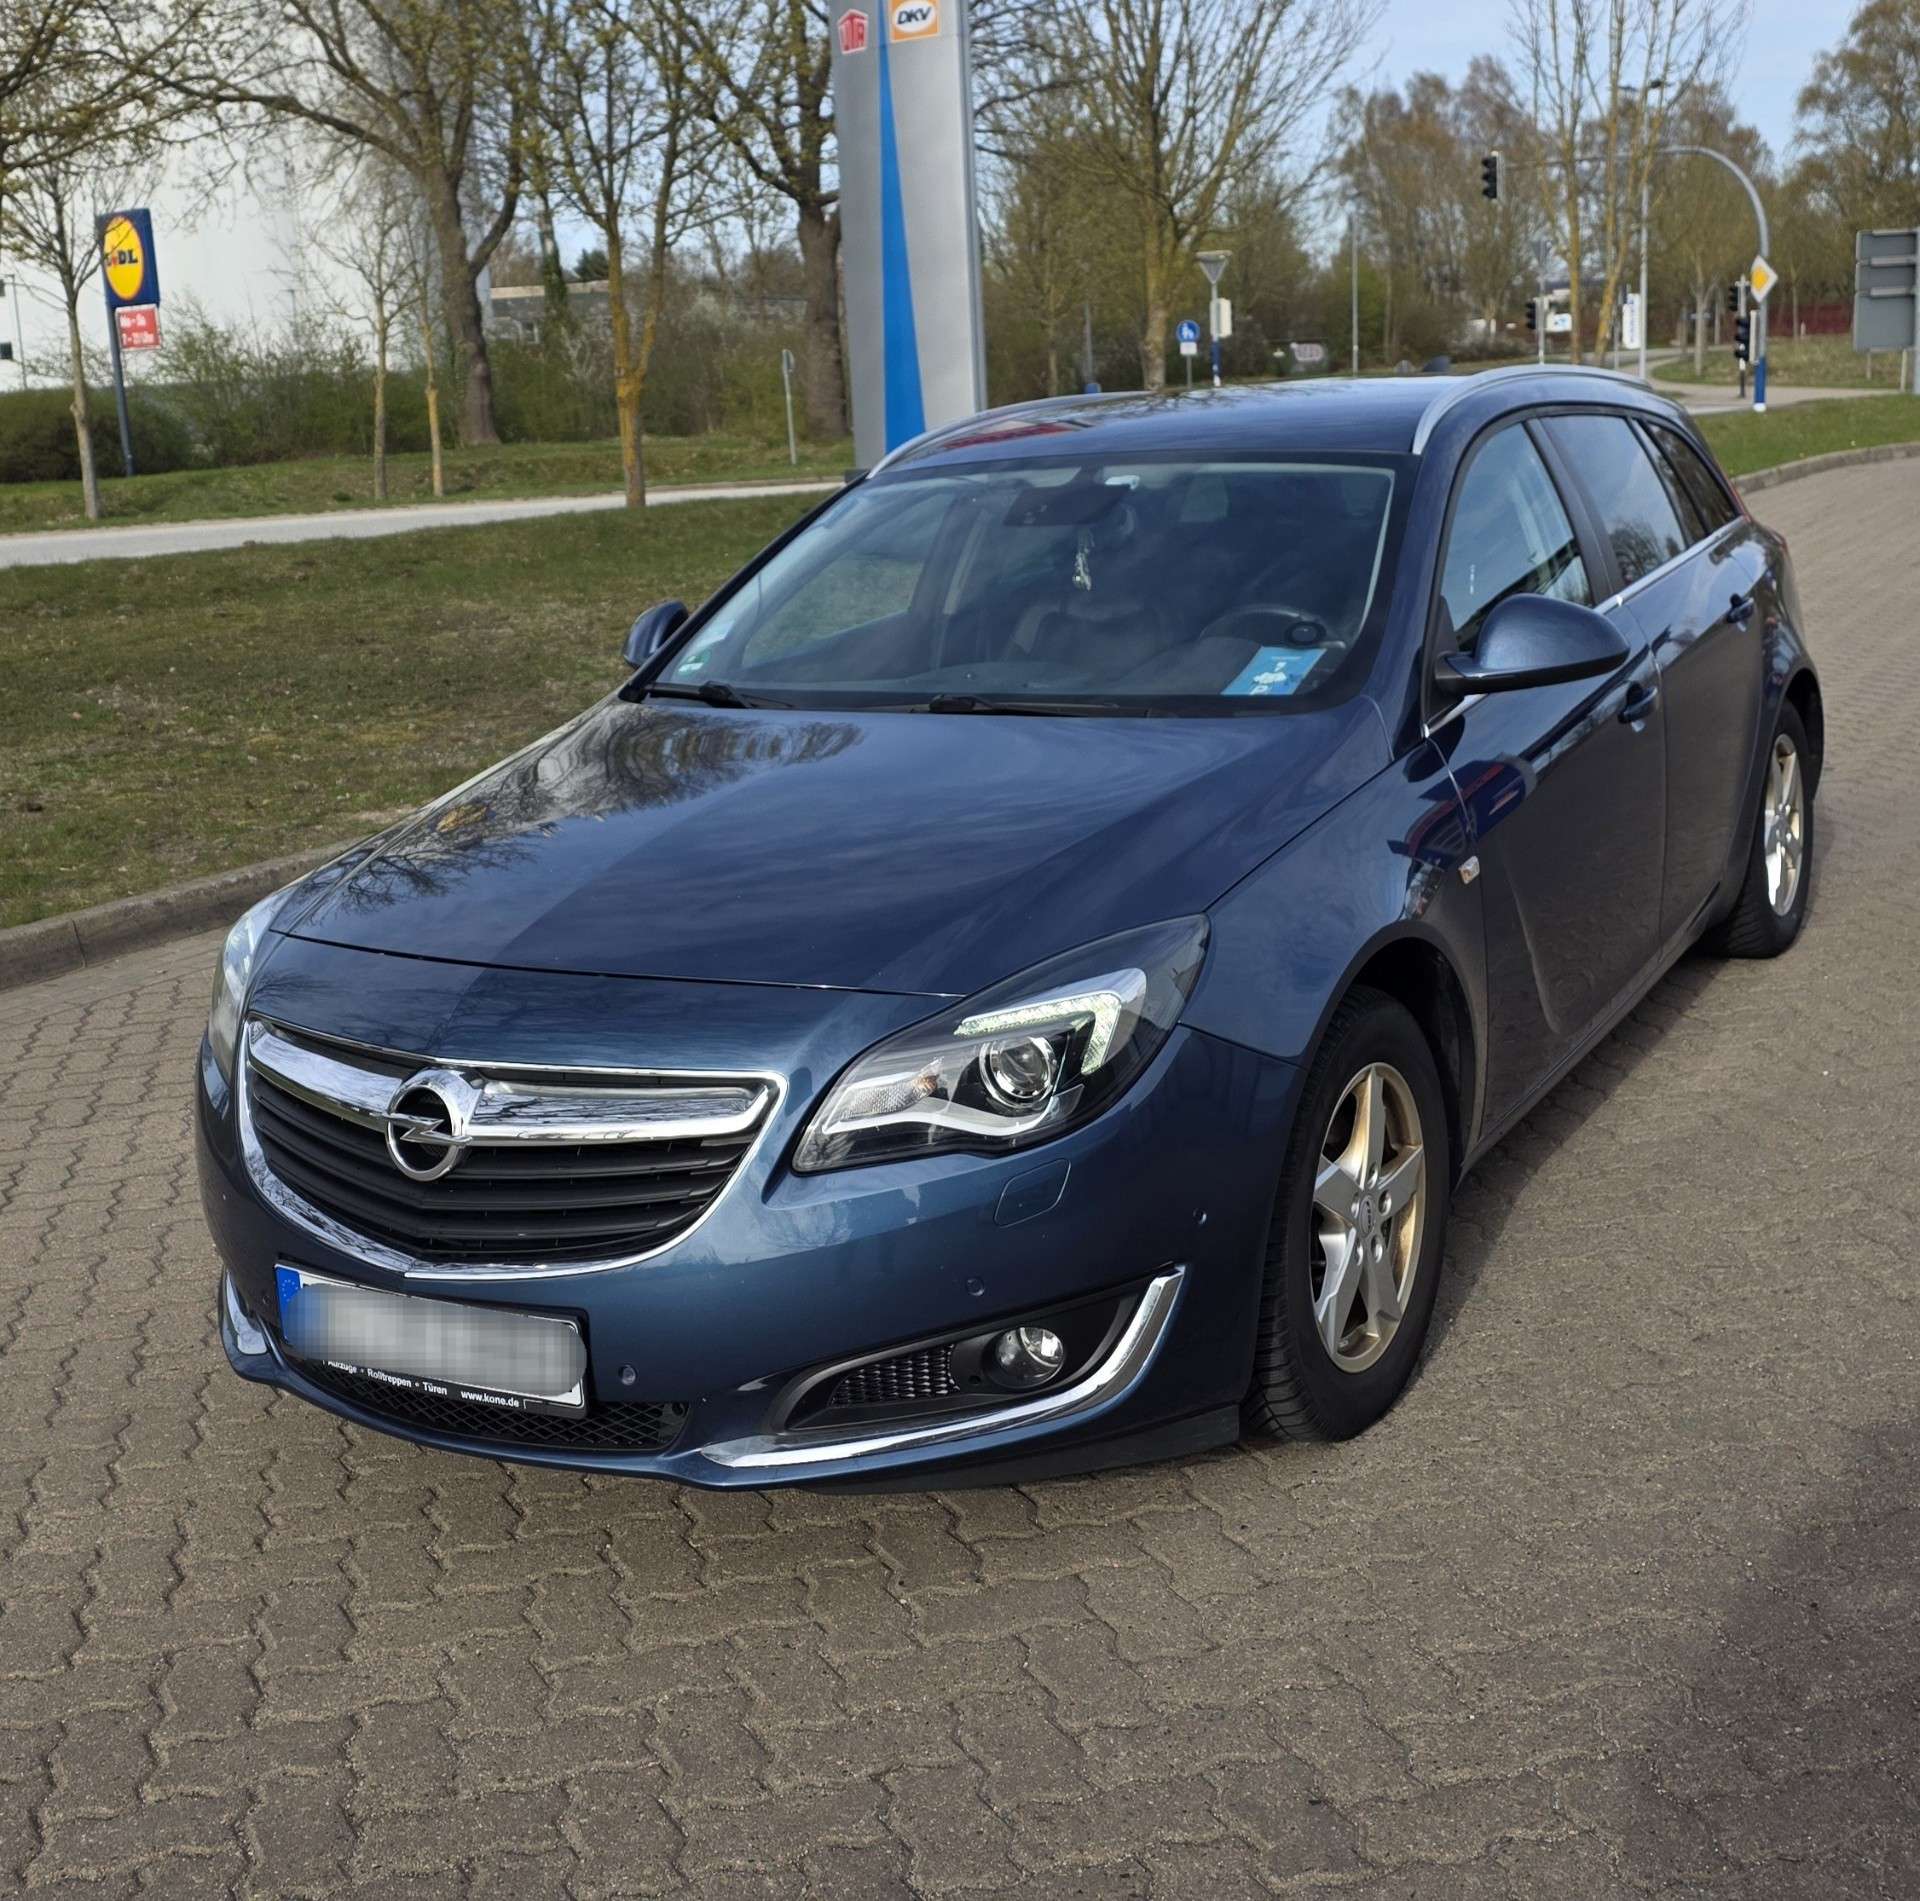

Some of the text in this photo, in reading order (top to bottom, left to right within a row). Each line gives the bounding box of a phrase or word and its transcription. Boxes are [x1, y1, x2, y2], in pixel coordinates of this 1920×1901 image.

[897, 7, 931, 25] DKV
[367, 1368, 411, 1387] Rolltreppen
[422, 1382, 448, 1395] Türen
[461, 1391, 520, 1408] www.kone.de
